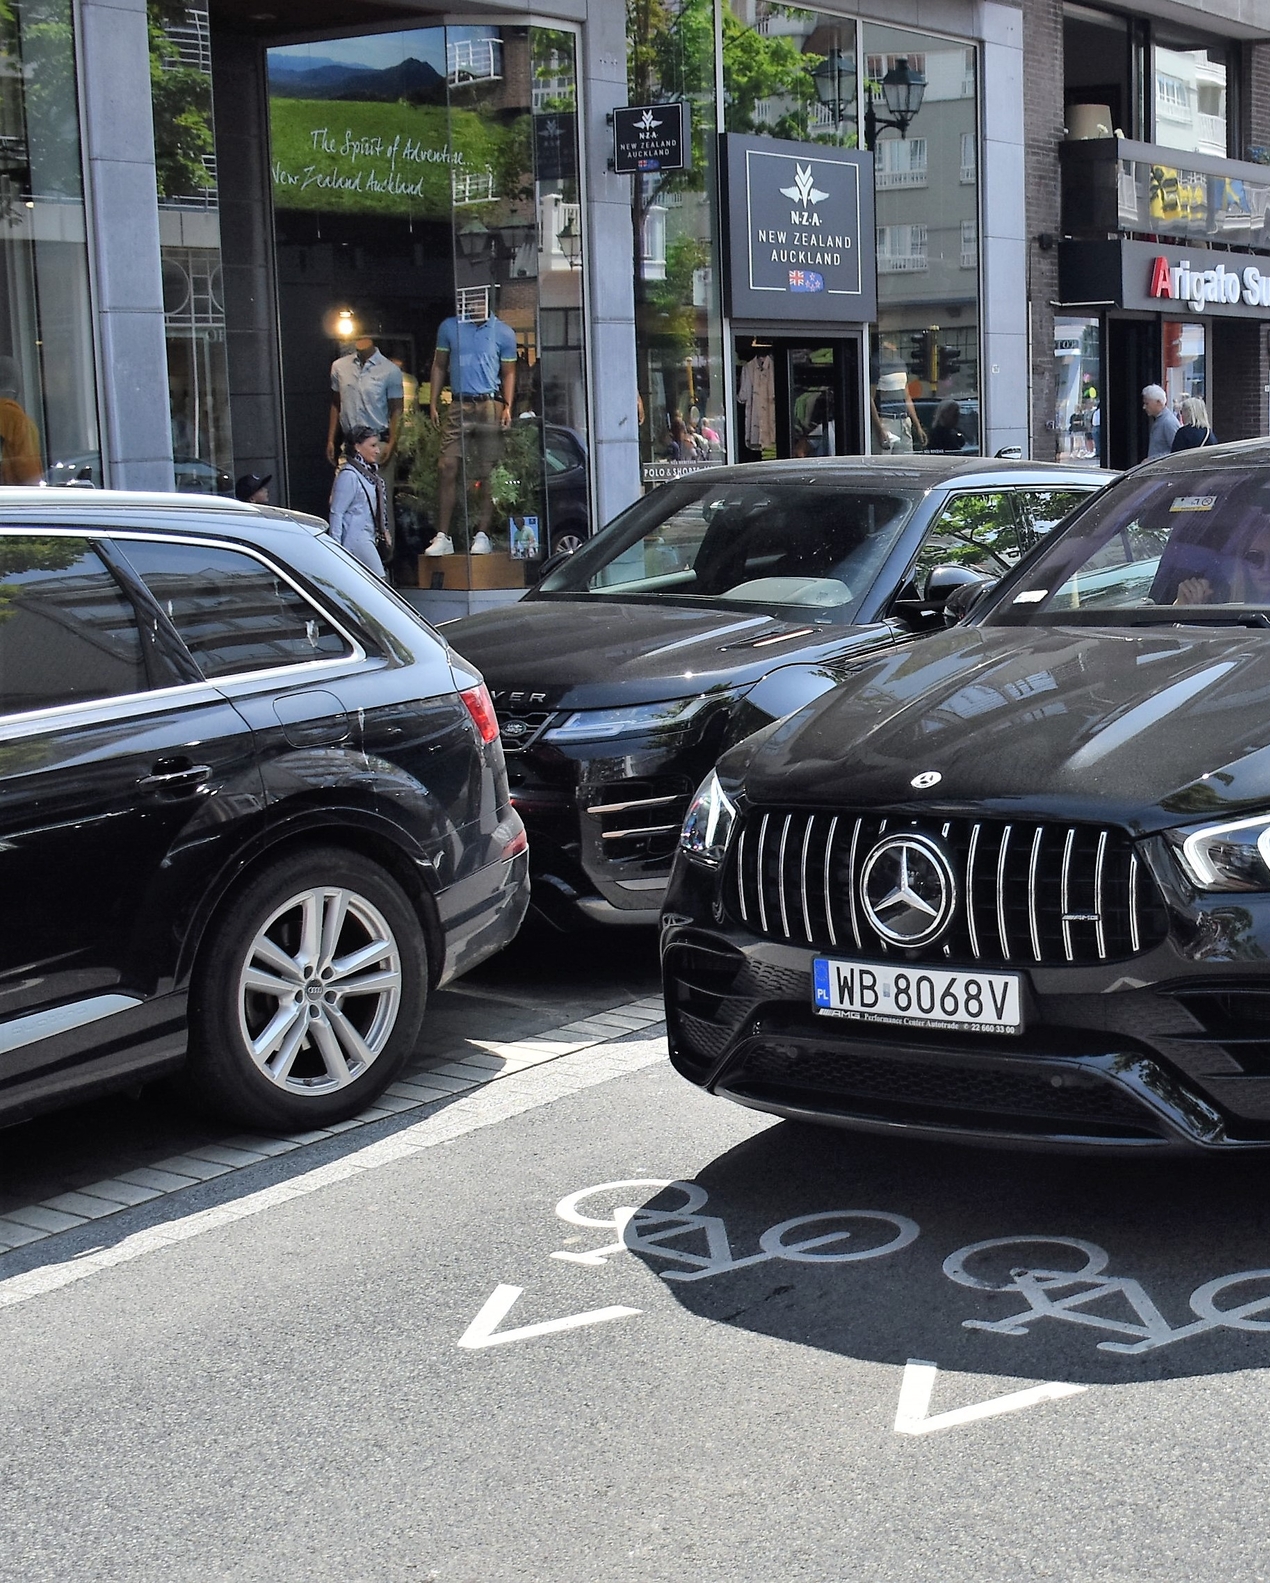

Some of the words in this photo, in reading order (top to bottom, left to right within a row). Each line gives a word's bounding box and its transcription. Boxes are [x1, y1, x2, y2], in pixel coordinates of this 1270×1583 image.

[311, 128, 335, 152] The
[340, 128, 383, 163] Spirit
[386, 135, 400, 170] of
[620, 143, 637, 151] NEW
[641, 140, 677, 149] ZEALAND
[627, 149, 670, 158] AUCKLAND
[301, 165, 362, 192] Zealand
[366, 169, 424, 198] Auckland
[758, 229, 787, 244] NEW
[794, 232, 851, 249] ZEALAND
[771, 249, 841, 266] AUCKLAND
[1150, 256, 1240, 312] Arigato
[644, 468, 665, 477] POLO
[666, 468, 672, 477] &
[817, 988, 829, 1000] PL
[836, 966, 879, 1008] WB
[894, 973, 1009, 1021] 8068V
[832, 1008, 861, 1019] AMG
[864, 1013, 903, 1025] Performance
[903, 1017, 925, 1027] Center
[926, 1020, 959, 1030] Autotrade
[971, 1023, 980, 1031] 22
[981, 1024, 995, 1032] 660
[995, 1025, 1005, 1033] 33
[1005, 1026, 1015, 1034] 00
